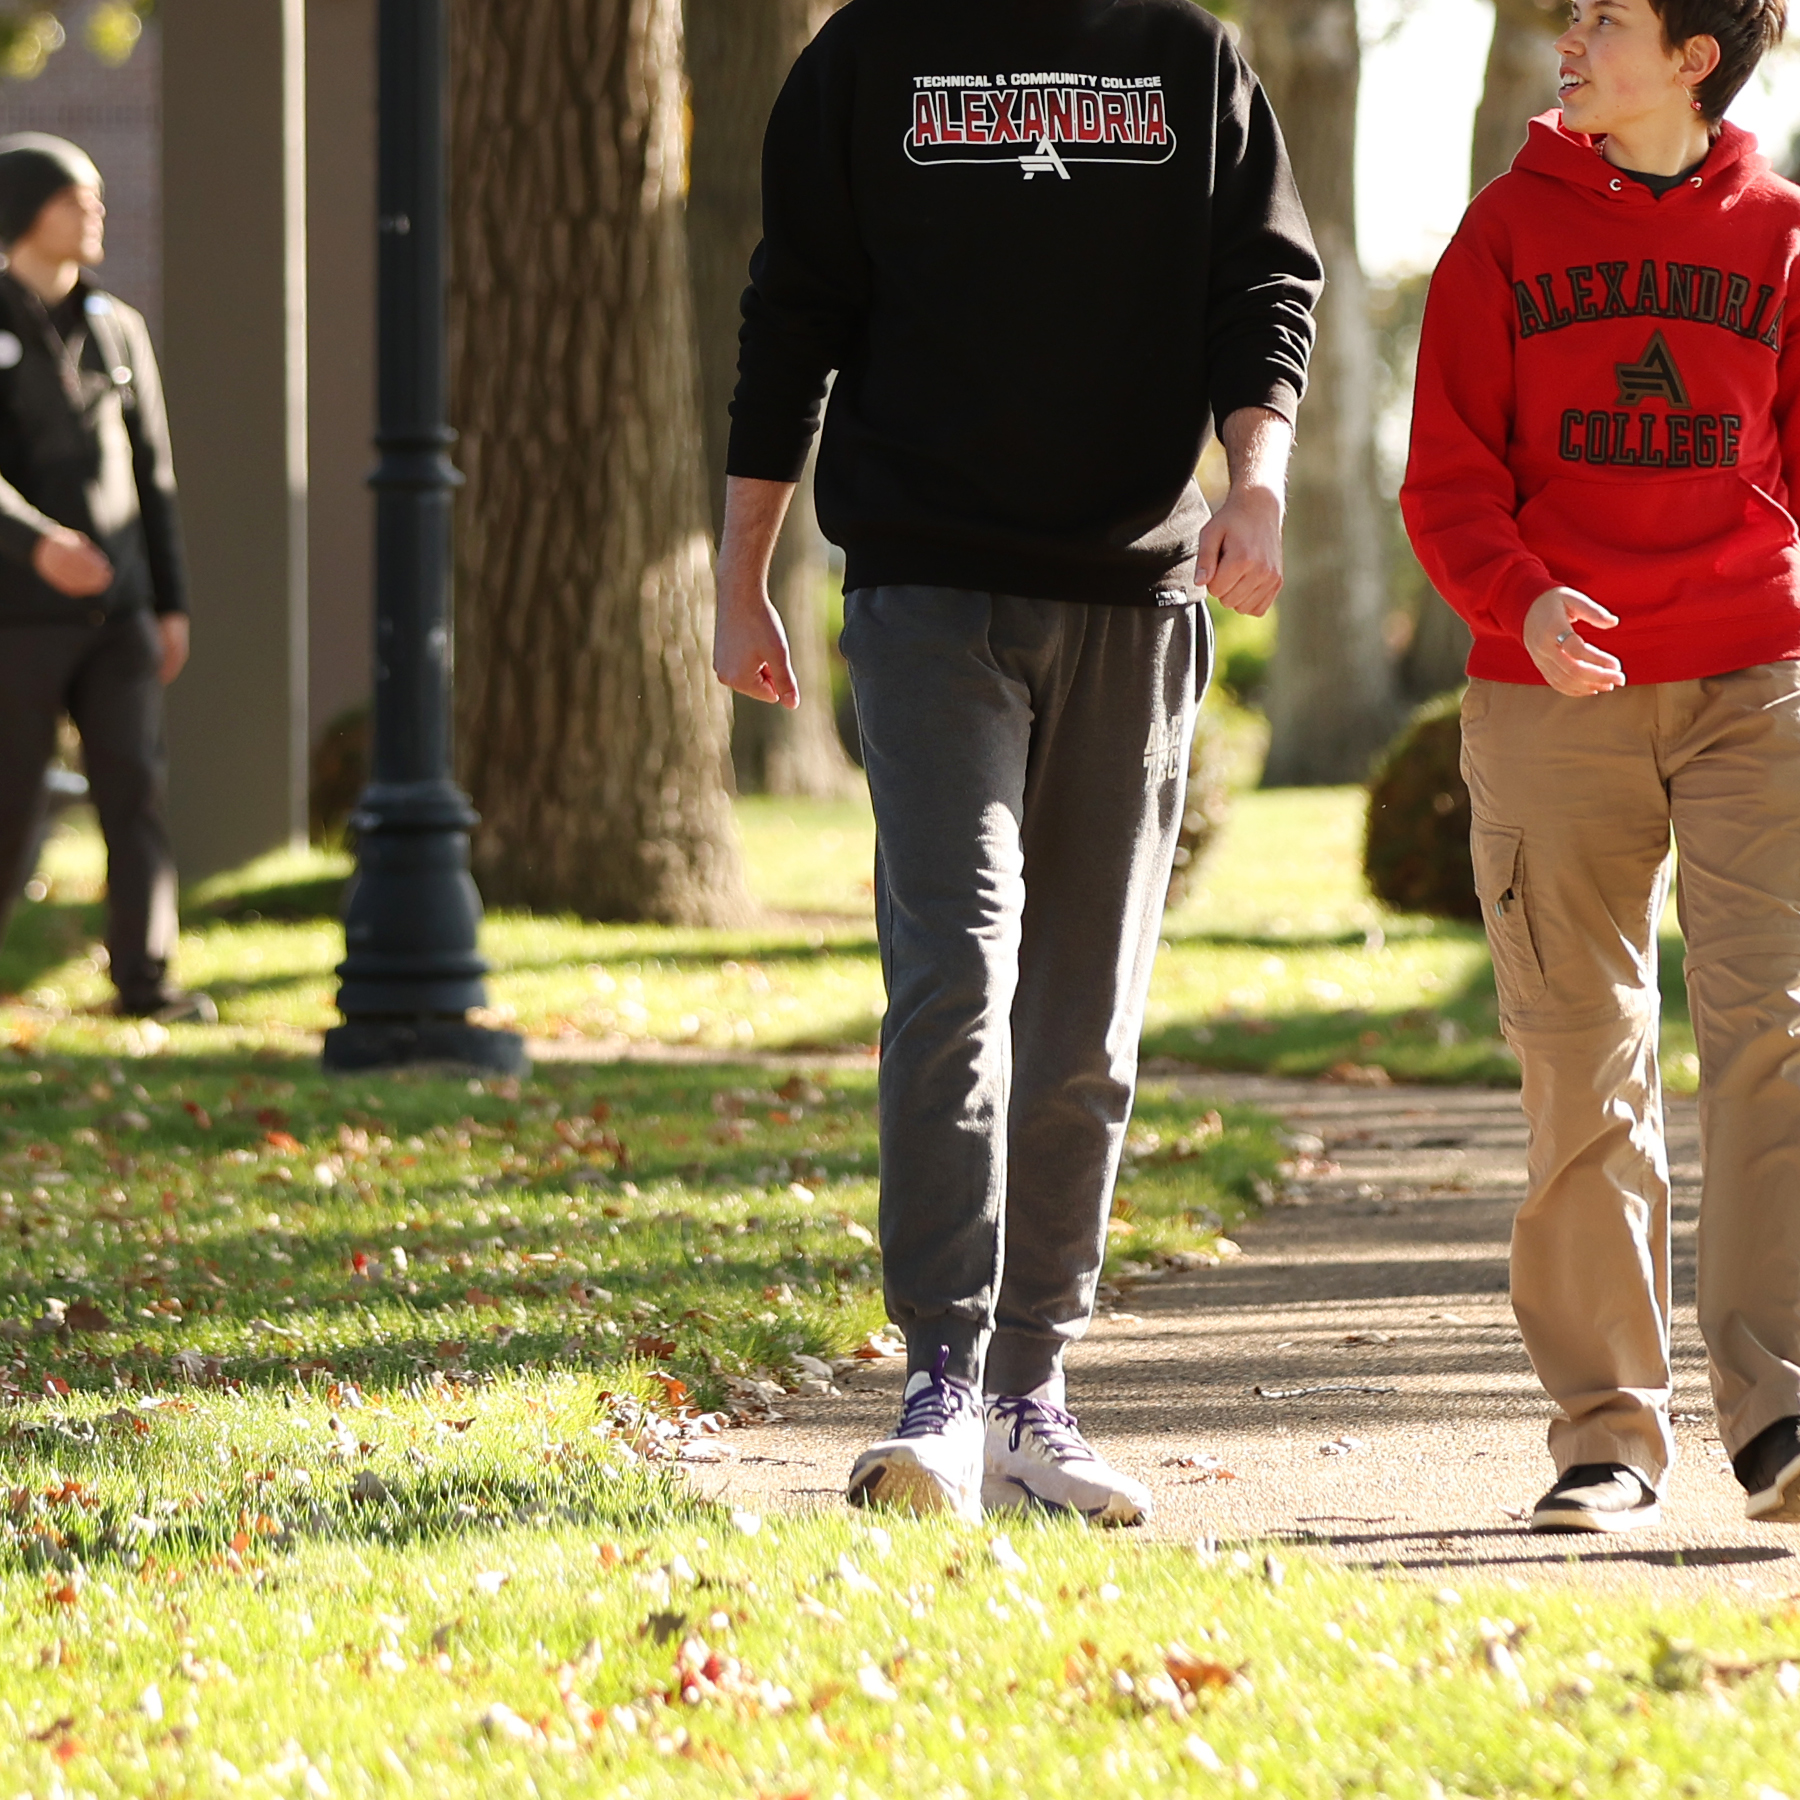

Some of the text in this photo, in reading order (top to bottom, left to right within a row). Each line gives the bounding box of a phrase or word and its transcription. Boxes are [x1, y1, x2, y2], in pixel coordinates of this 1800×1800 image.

[913, 72, 1162, 89] TECHNICAL & COMMUNITY COLLEGE
[913, 88, 1167, 146] ALEXANDRIA
[1513, 259, 1788, 354] ALEXANDRIA
[1559, 409, 1742, 468] COLLEGE
